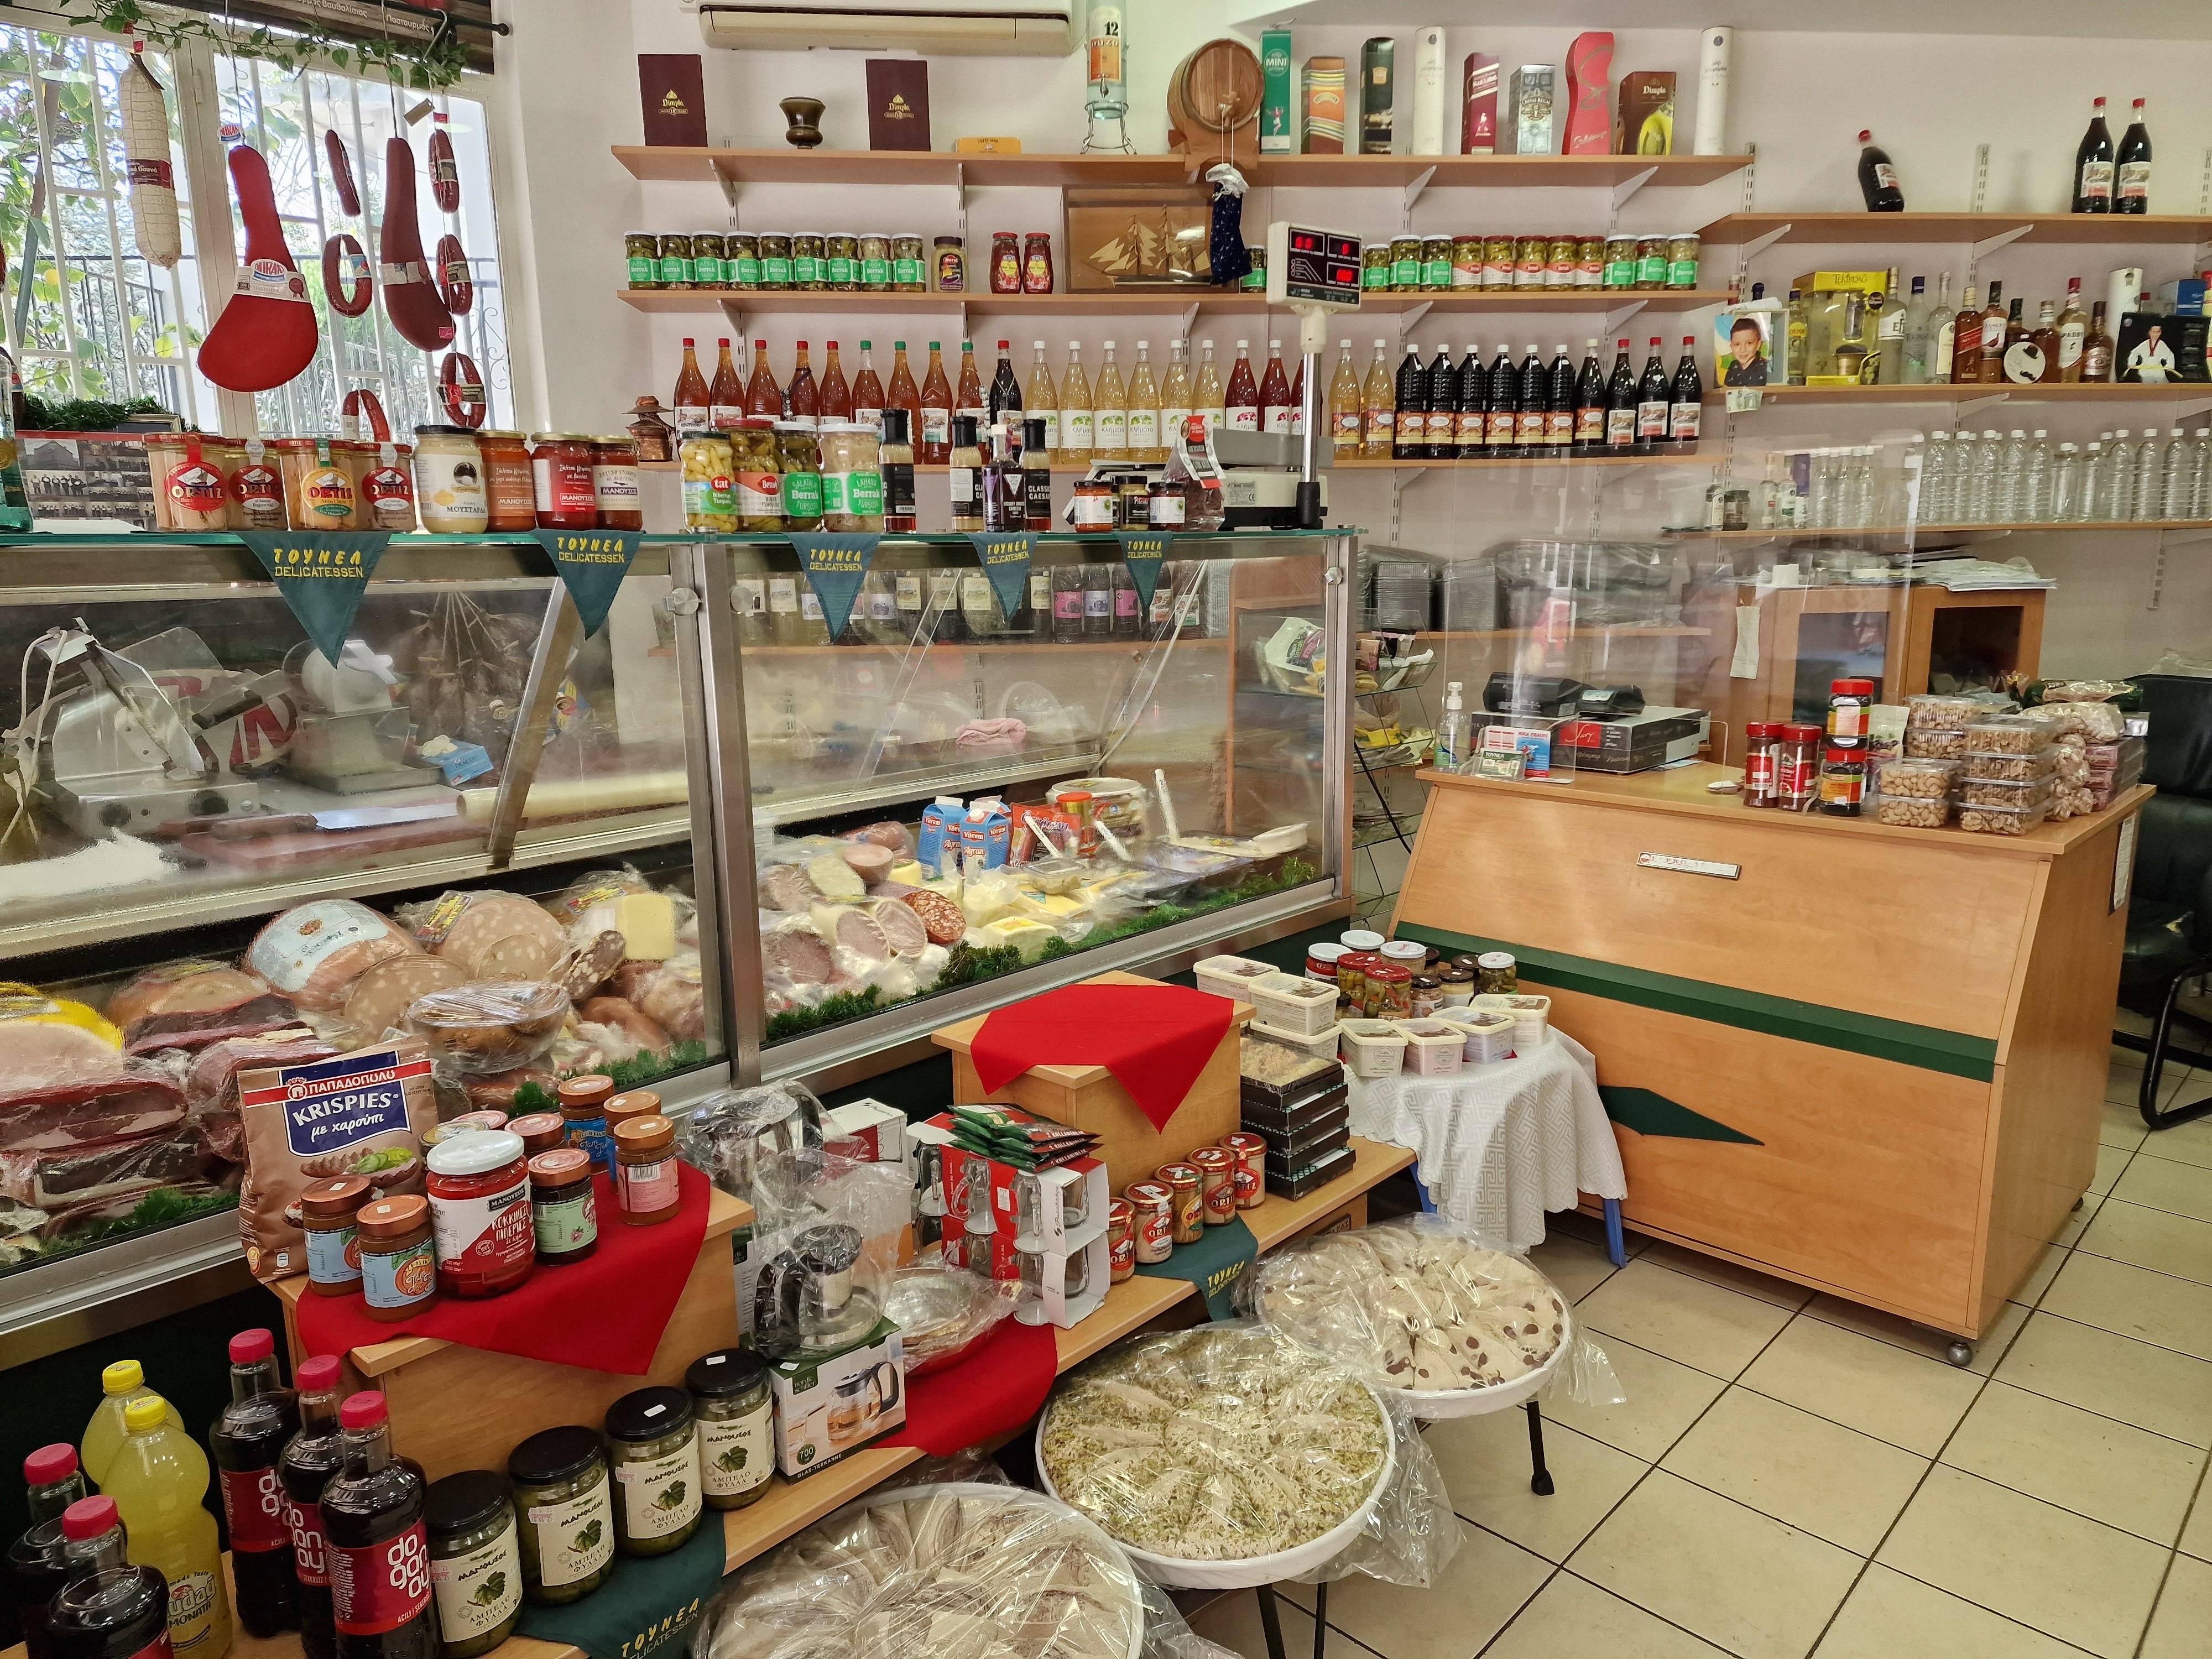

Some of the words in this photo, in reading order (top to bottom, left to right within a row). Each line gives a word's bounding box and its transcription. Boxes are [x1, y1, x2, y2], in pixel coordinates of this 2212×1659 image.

[1104, 20, 1119, 36] 12
[1265, 58, 1287, 67] MINI
[714, 478, 729, 488] tat
[307, 487, 353, 499] ORTIZ
[792, 489, 819, 499] Berrak
[853, 488, 880, 498] Berrak
[559, 551, 625, 563] DELICATESSEN
[987, 550, 1029, 565] DELICATESSEN
[1127, 551, 1162, 559] DELICATESSEN
[275, 566, 364, 578] DELICATESSEN
[810, 562, 863, 571] DELICATESSEN
[964, 846, 985, 856] Ayran
[292, 1093, 392, 1126] KRISPIES
[311, 1125, 328, 1143] με
[332, 1113, 385, 1135] χαρούπι
[491, 1188, 524, 1207] ΜΑΝΟΥΣΟΣ
[1211, 1194, 1234, 1207] ORTI
[492, 1204, 527, 1231] ΚΟΚΚΙΝΕΣ
[496, 1217, 527, 1241] ΠΙΠΕΡΙΕΣ
[799, 1448, 814, 1459] 700
[797, 1453, 842, 1479] GLAS-TEEKANNE
[712, 1471, 751, 1483] ΑΜΠΕΛΟ
[717, 1478, 747, 1489] ΦΥΛΛΑ
[651, 1505, 689, 1525] ΑΜΠΕΛΟ
[656, 1514, 686, 1528] ΦΥΛΛΑ
[388, 1533, 418, 1567] do
[567, 1544, 606, 1569] ΑΜΠΕΛΟ
[296, 1548, 325, 1574] ay
[573, 1553, 603, 1572] ΦΥΛΛΑ
[168, 1601, 212, 1629] MONATA
[469, 1595, 510, 1623] ΑΜΠΕΛΟ
[476, 1605, 508, 1626] ΦΥΛΛΑ
[397, 1610, 412, 1624] ACILI
[629, 1609, 698, 1659] ELICATESSEN
